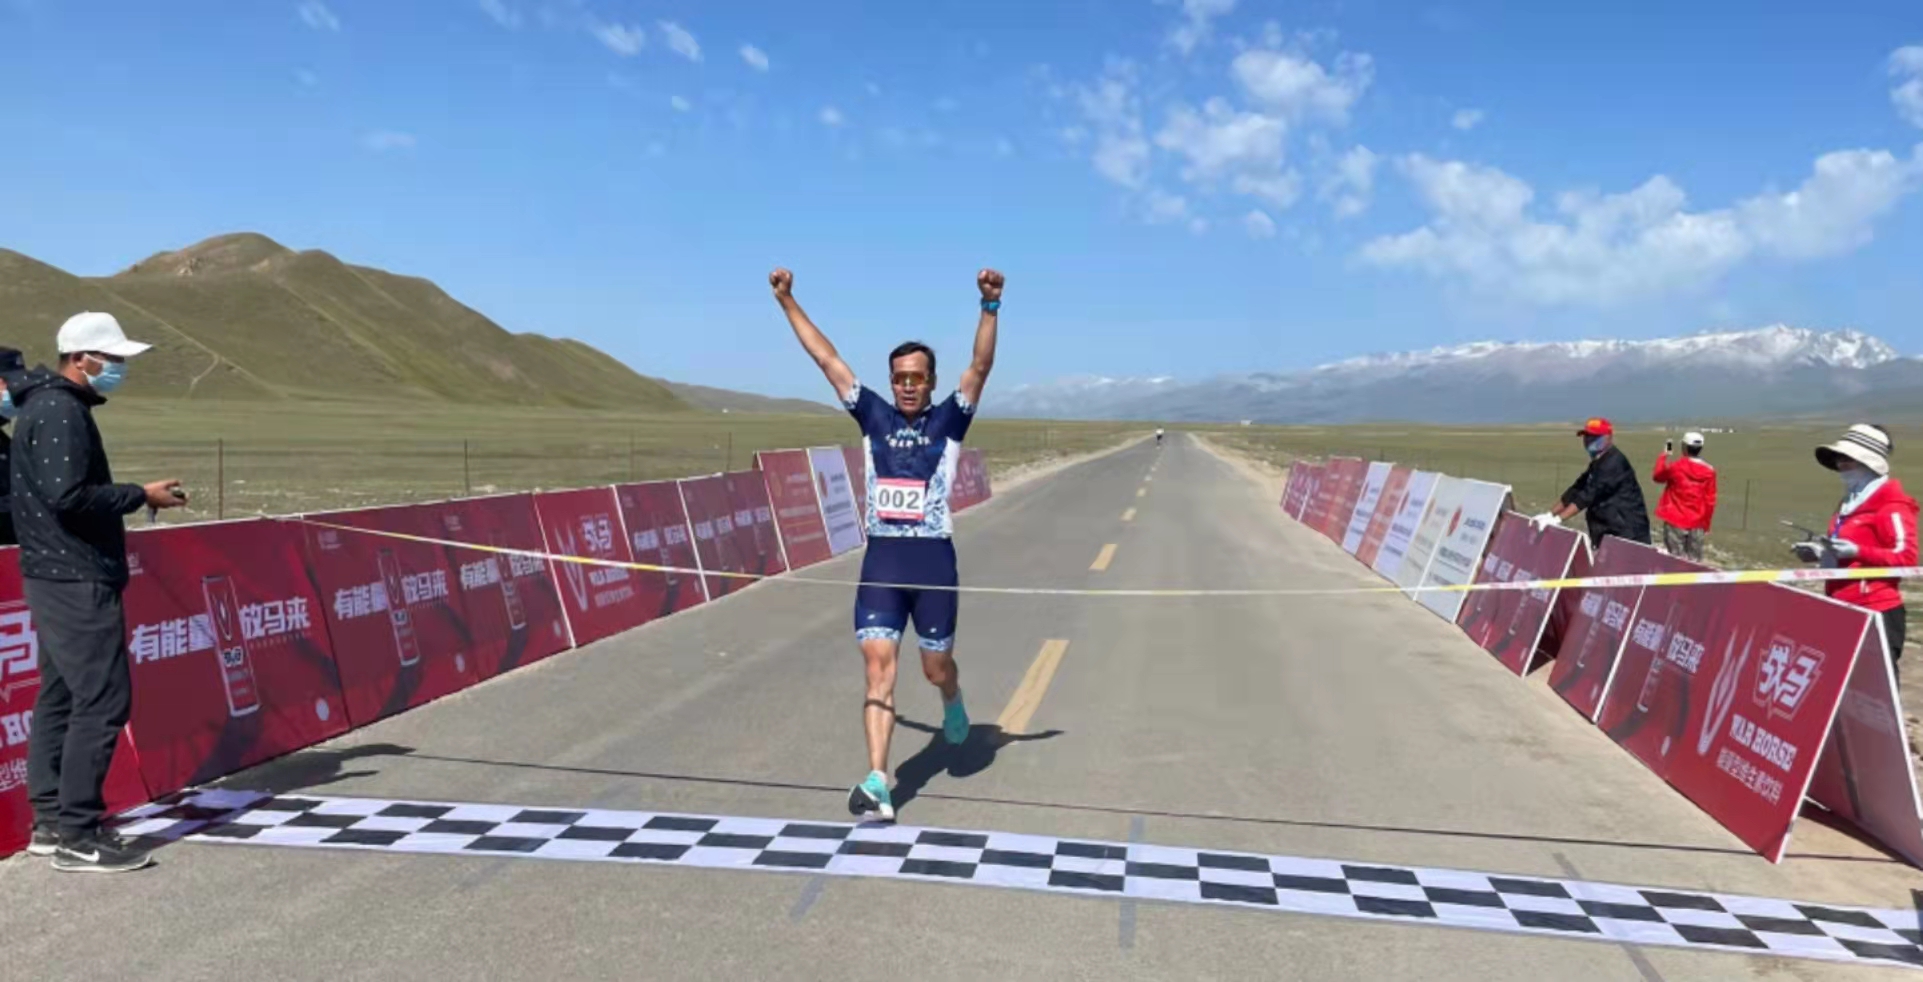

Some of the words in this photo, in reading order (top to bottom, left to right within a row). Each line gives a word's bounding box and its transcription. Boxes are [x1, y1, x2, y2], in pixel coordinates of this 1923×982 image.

[878, 488, 920, 510] 002
[128, 613, 216, 664] 有能量
[240, 596, 311, 640] 放马来
[334, 582, 388, 630] 有能量
[402, 569, 448, 604] 放马来
[0, 610, 39, 682] 马
[1759, 643, 1817, 708] 战马
[1750, 727, 1798, 773] HORSE
